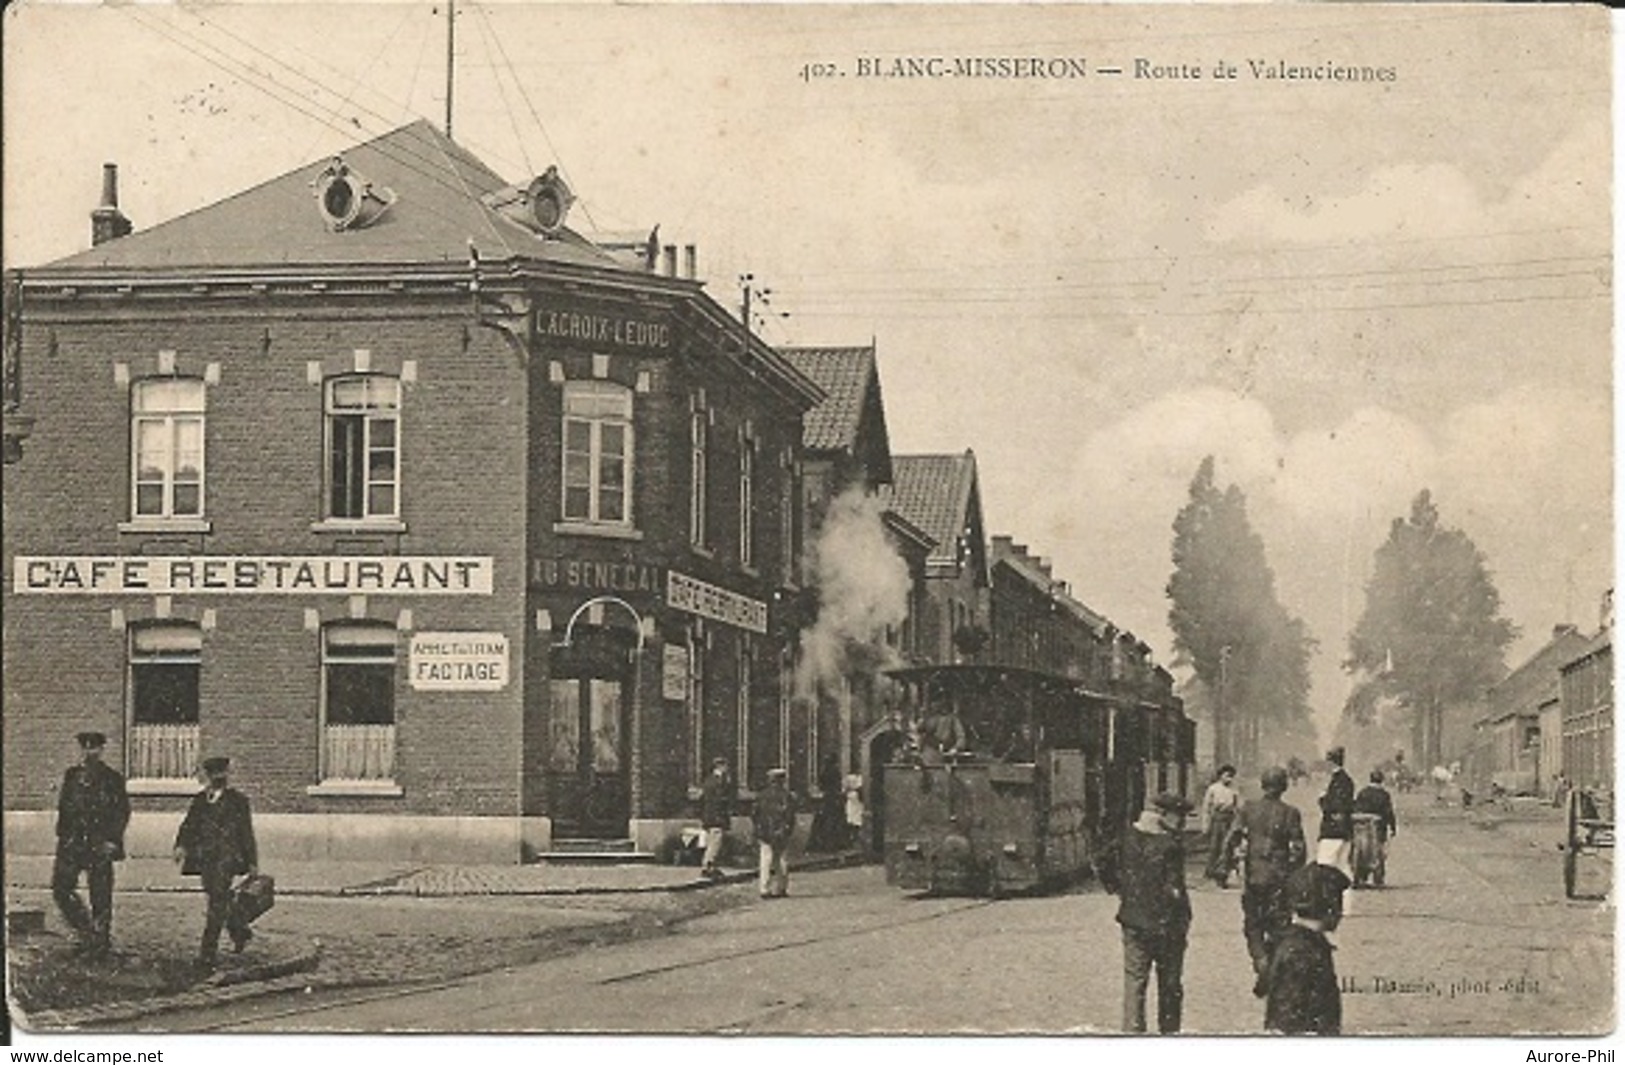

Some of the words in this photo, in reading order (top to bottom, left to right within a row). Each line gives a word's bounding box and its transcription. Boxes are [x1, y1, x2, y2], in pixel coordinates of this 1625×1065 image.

[856, 58, 1087, 78] BLANC-MISSERON
[1134, 58, 1201, 79] Route
[1213, 60, 1237, 79] de
[1249, 59, 1397, 81] Valenciennes
[169, 560, 481, 589] RESTAURANT
[416, 662, 501, 681] FACTAGE
